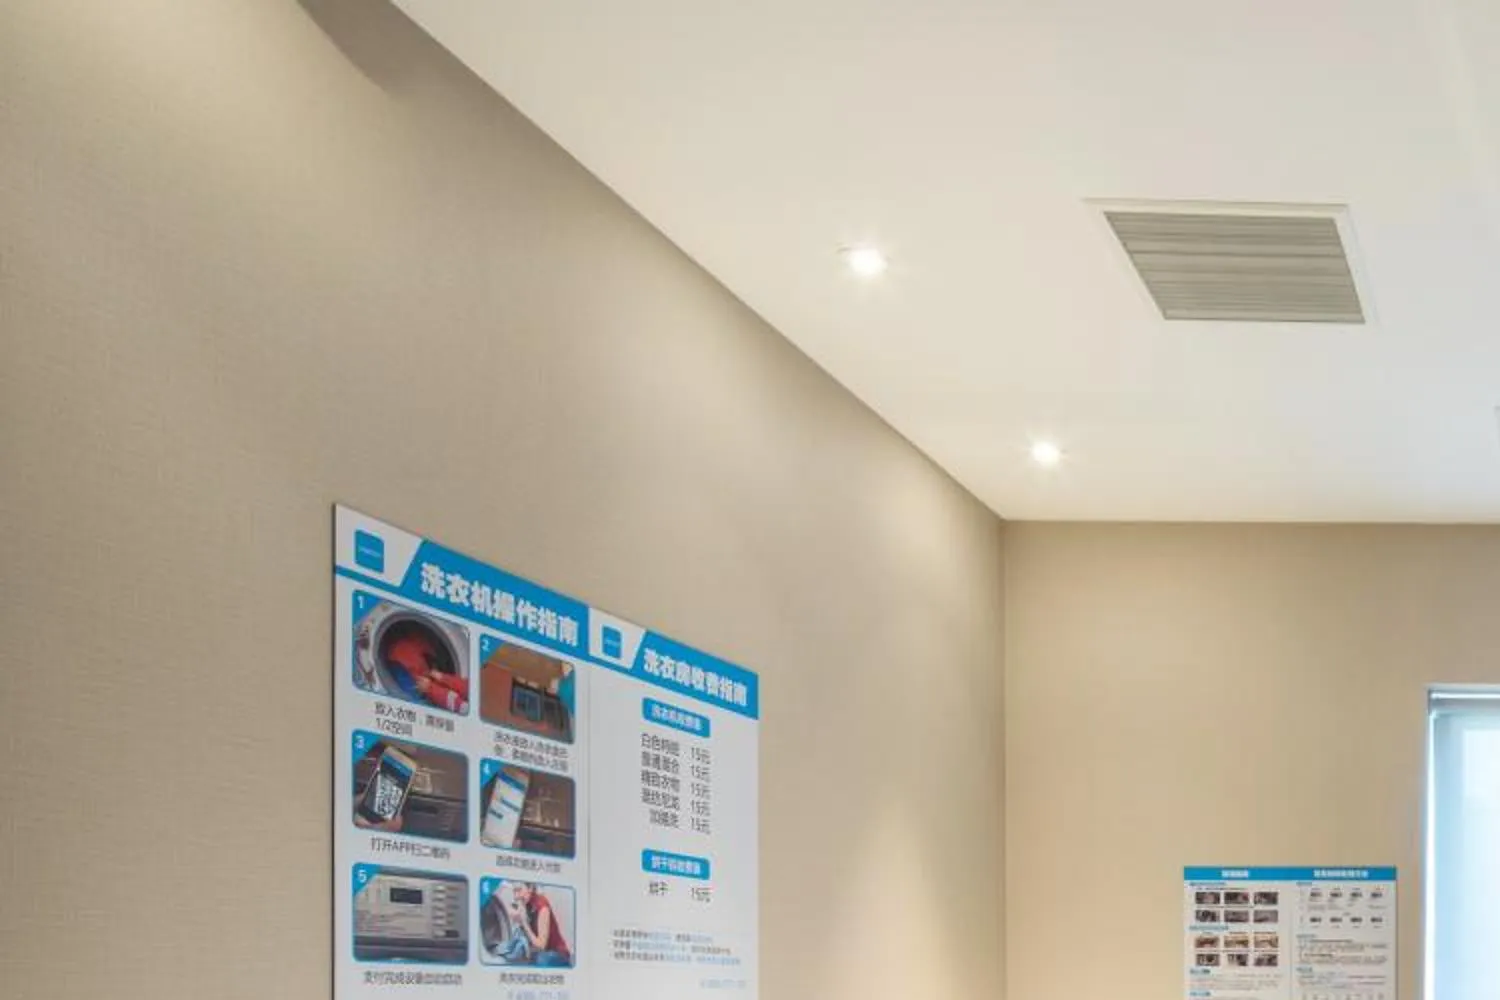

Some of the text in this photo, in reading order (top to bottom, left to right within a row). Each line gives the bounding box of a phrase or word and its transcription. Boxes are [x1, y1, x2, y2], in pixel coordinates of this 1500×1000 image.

[421, 562, 579, 647] 洗衣机操作指南
